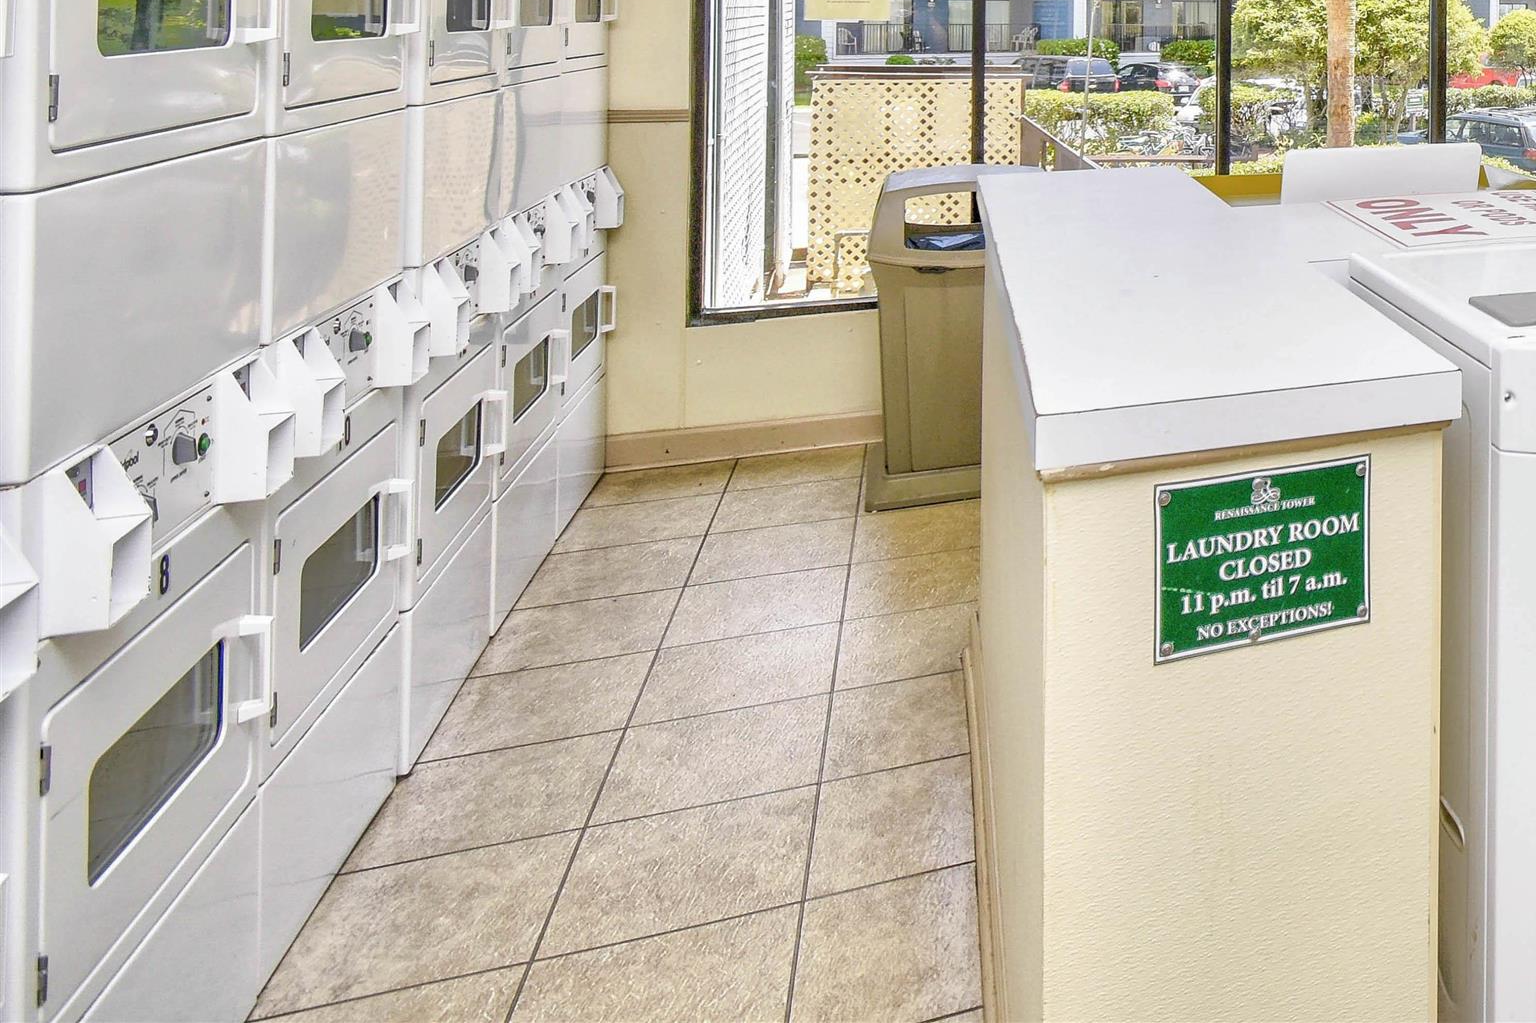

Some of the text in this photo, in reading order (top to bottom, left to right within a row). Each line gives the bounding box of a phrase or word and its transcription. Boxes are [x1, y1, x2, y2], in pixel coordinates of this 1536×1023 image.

[1356, 199, 1490, 237] ONLY
[1214, 495, 1315, 522] RENAISSANCE TOWER
[1166, 512, 1360, 564] LAUNDRY ROOM
[159, 554, 170, 596] 8
[1217, 547, 1312, 582] CLOSED
[1181, 572, 1348, 615] 11 p.m. til 7 a.m.
[1196, 601, 1333, 641] NO EXCEPTIONS!
